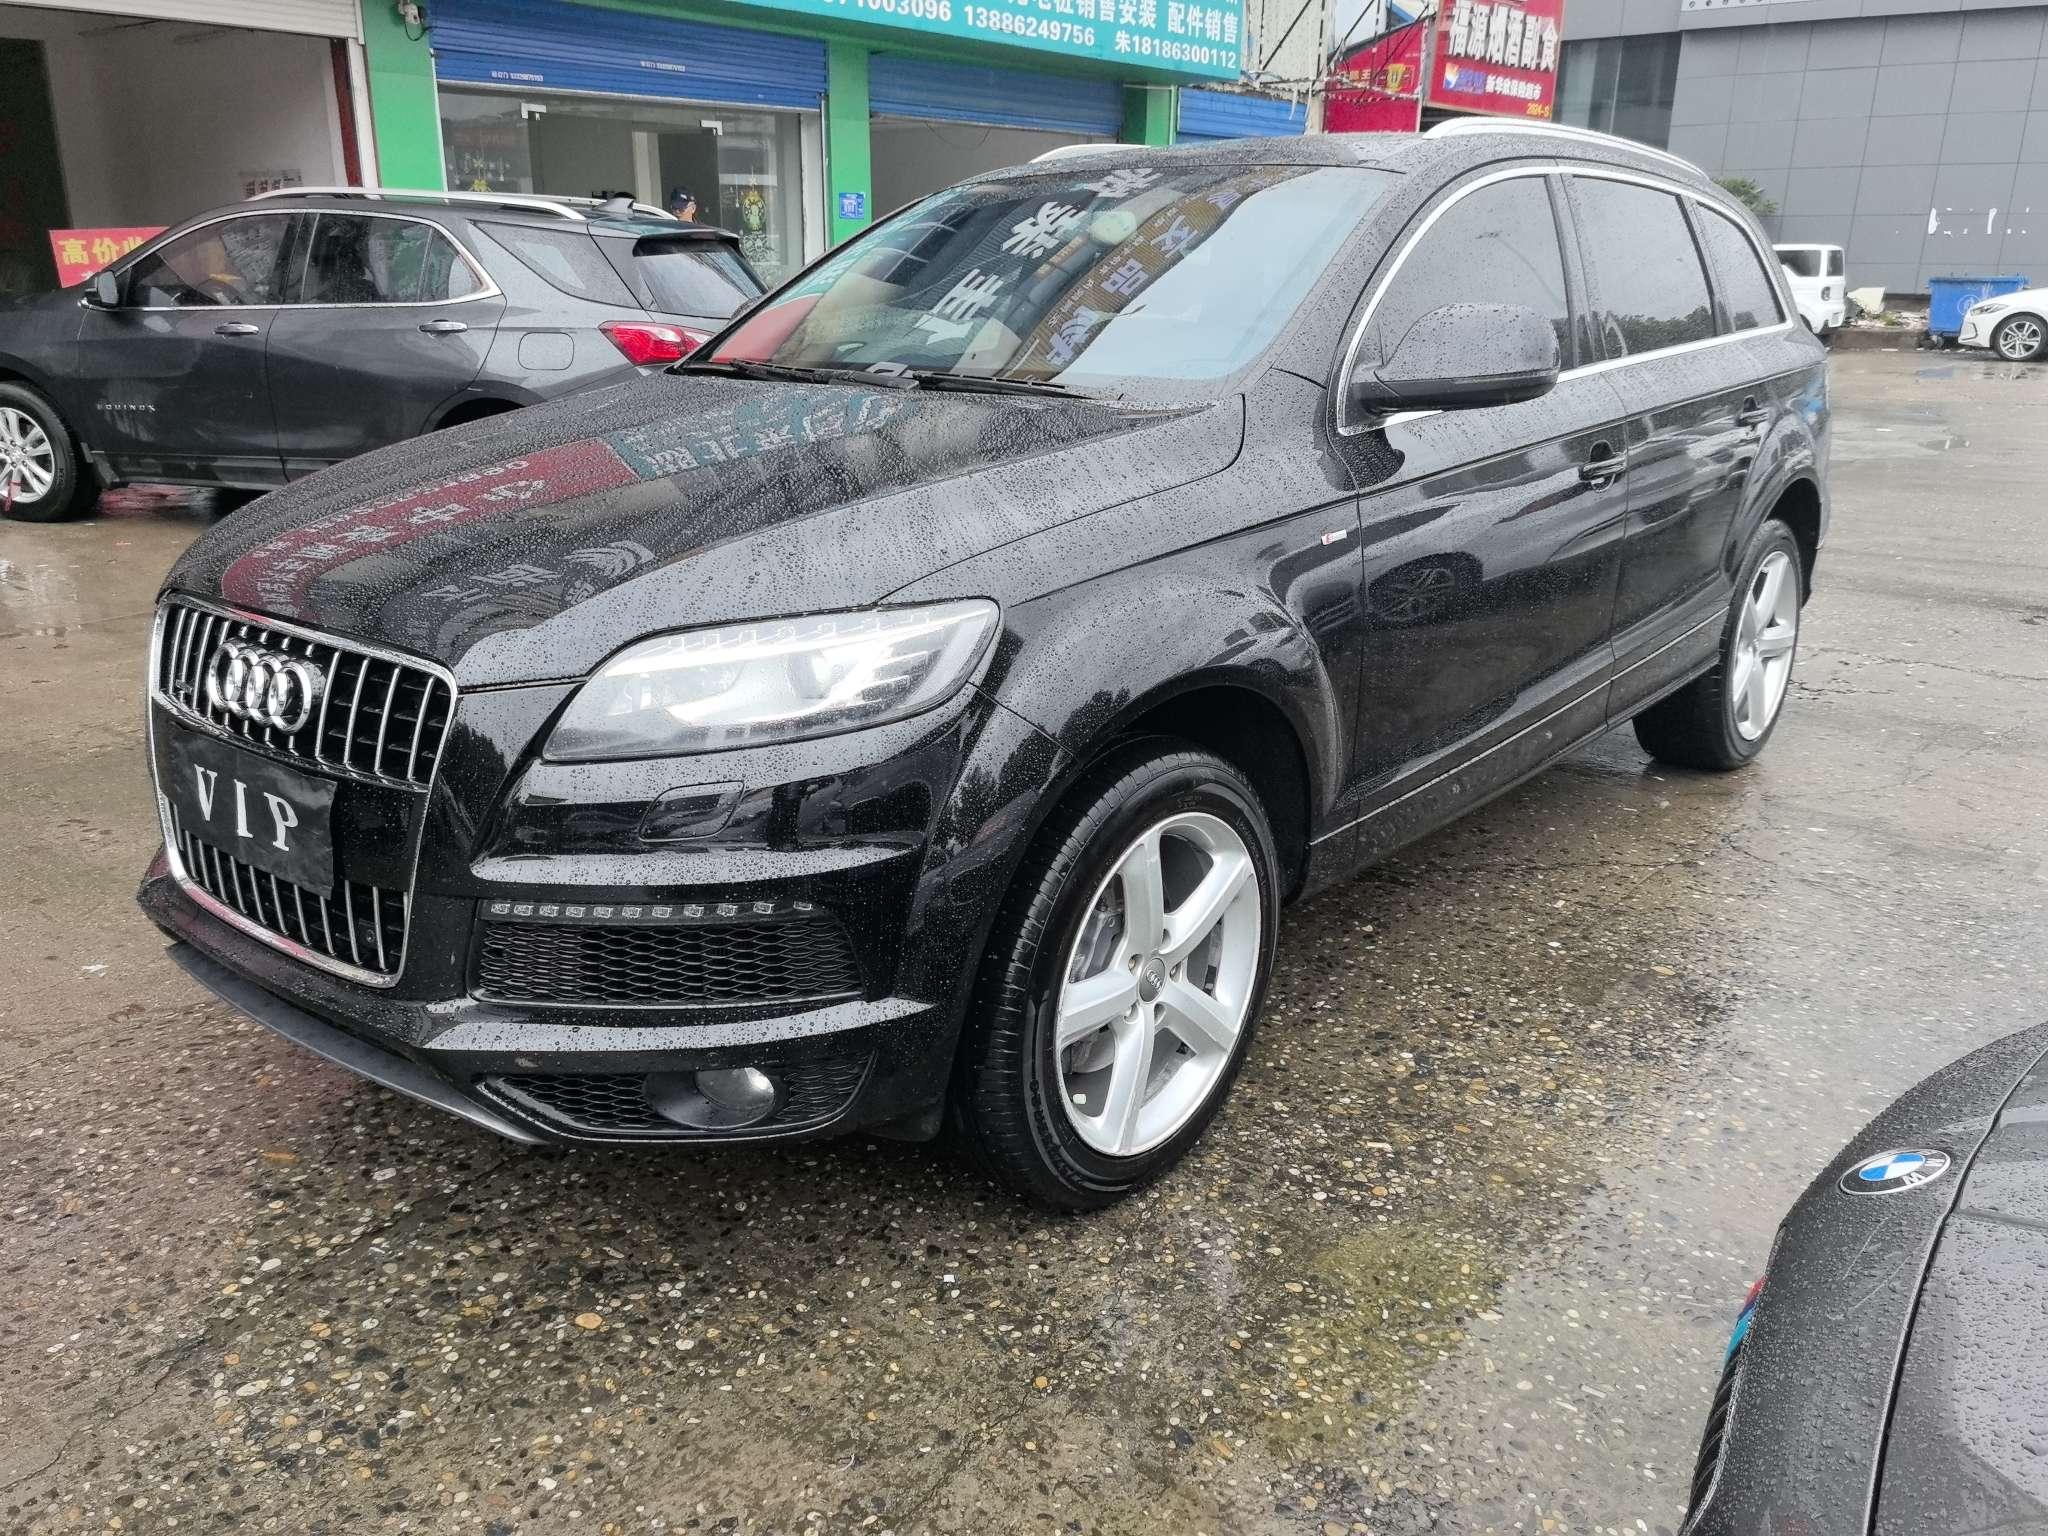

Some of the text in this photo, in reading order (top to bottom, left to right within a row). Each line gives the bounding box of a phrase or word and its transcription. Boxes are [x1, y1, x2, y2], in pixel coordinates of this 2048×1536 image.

[823, 0, 1236, 69] 003096 13886249756 朱18186300112
[1007, 0, 1239, 44] 销售安装 配件销售
[1449, 0, 1558, 72] 福源烟酒副食
[193, 763, 299, 852] VIP
